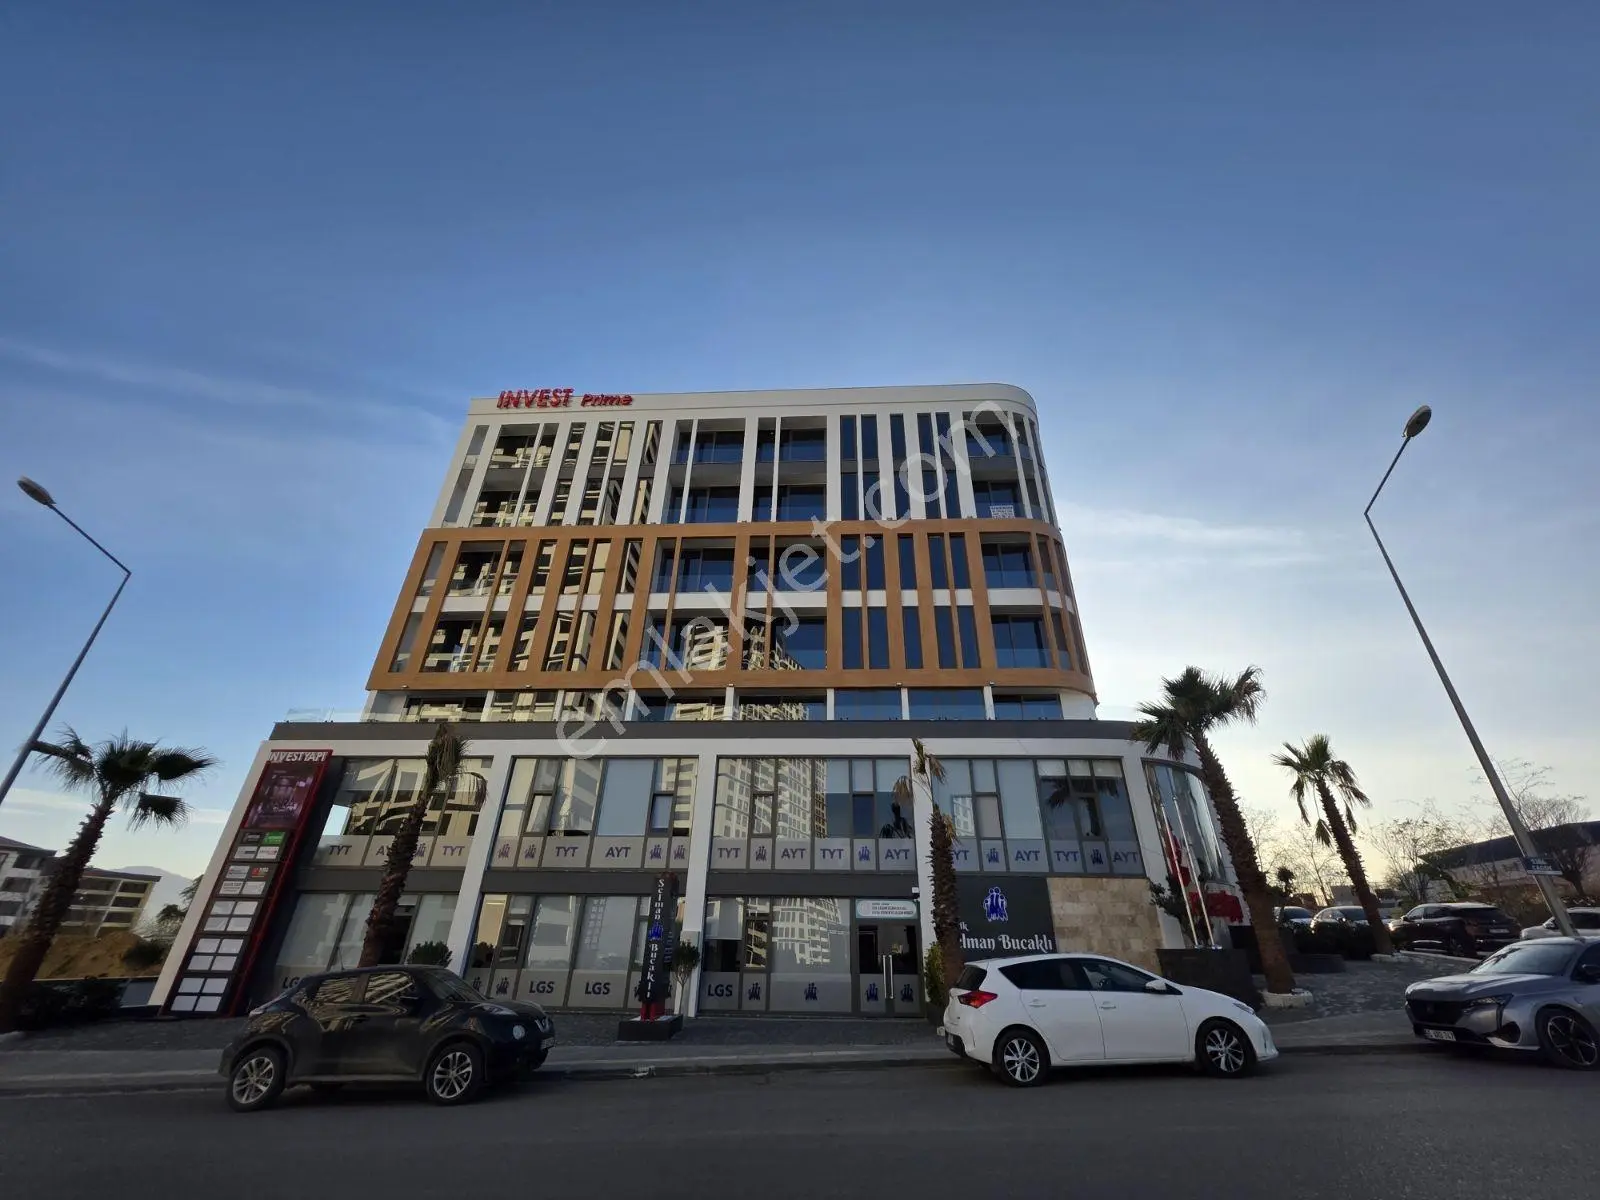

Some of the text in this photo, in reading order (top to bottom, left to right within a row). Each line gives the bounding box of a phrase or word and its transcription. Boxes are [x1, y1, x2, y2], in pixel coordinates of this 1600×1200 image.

[496, 388, 575, 409] INVEST
[329, 845, 352, 855] TYT
[443, 846, 465, 856] TYT
[555, 846, 578, 857] TYT
[605, 847, 631, 858] AYT
[718, 847, 741, 859] TYT
[781, 848, 806, 859] AYT
[820, 848, 844, 859] TYT
[885, 848, 910, 860] AYT
[953, 850, 970, 861] YT
[1015, 850, 1040, 861] AYT
[1054, 851, 1079, 862] TYT
[1113, 851, 1139, 862] AYT
[960, 933, 995, 950] lman
[529, 981, 555, 994] LGS
[585, 982, 611, 995] LGS
[707, 984, 733, 997] LGS
